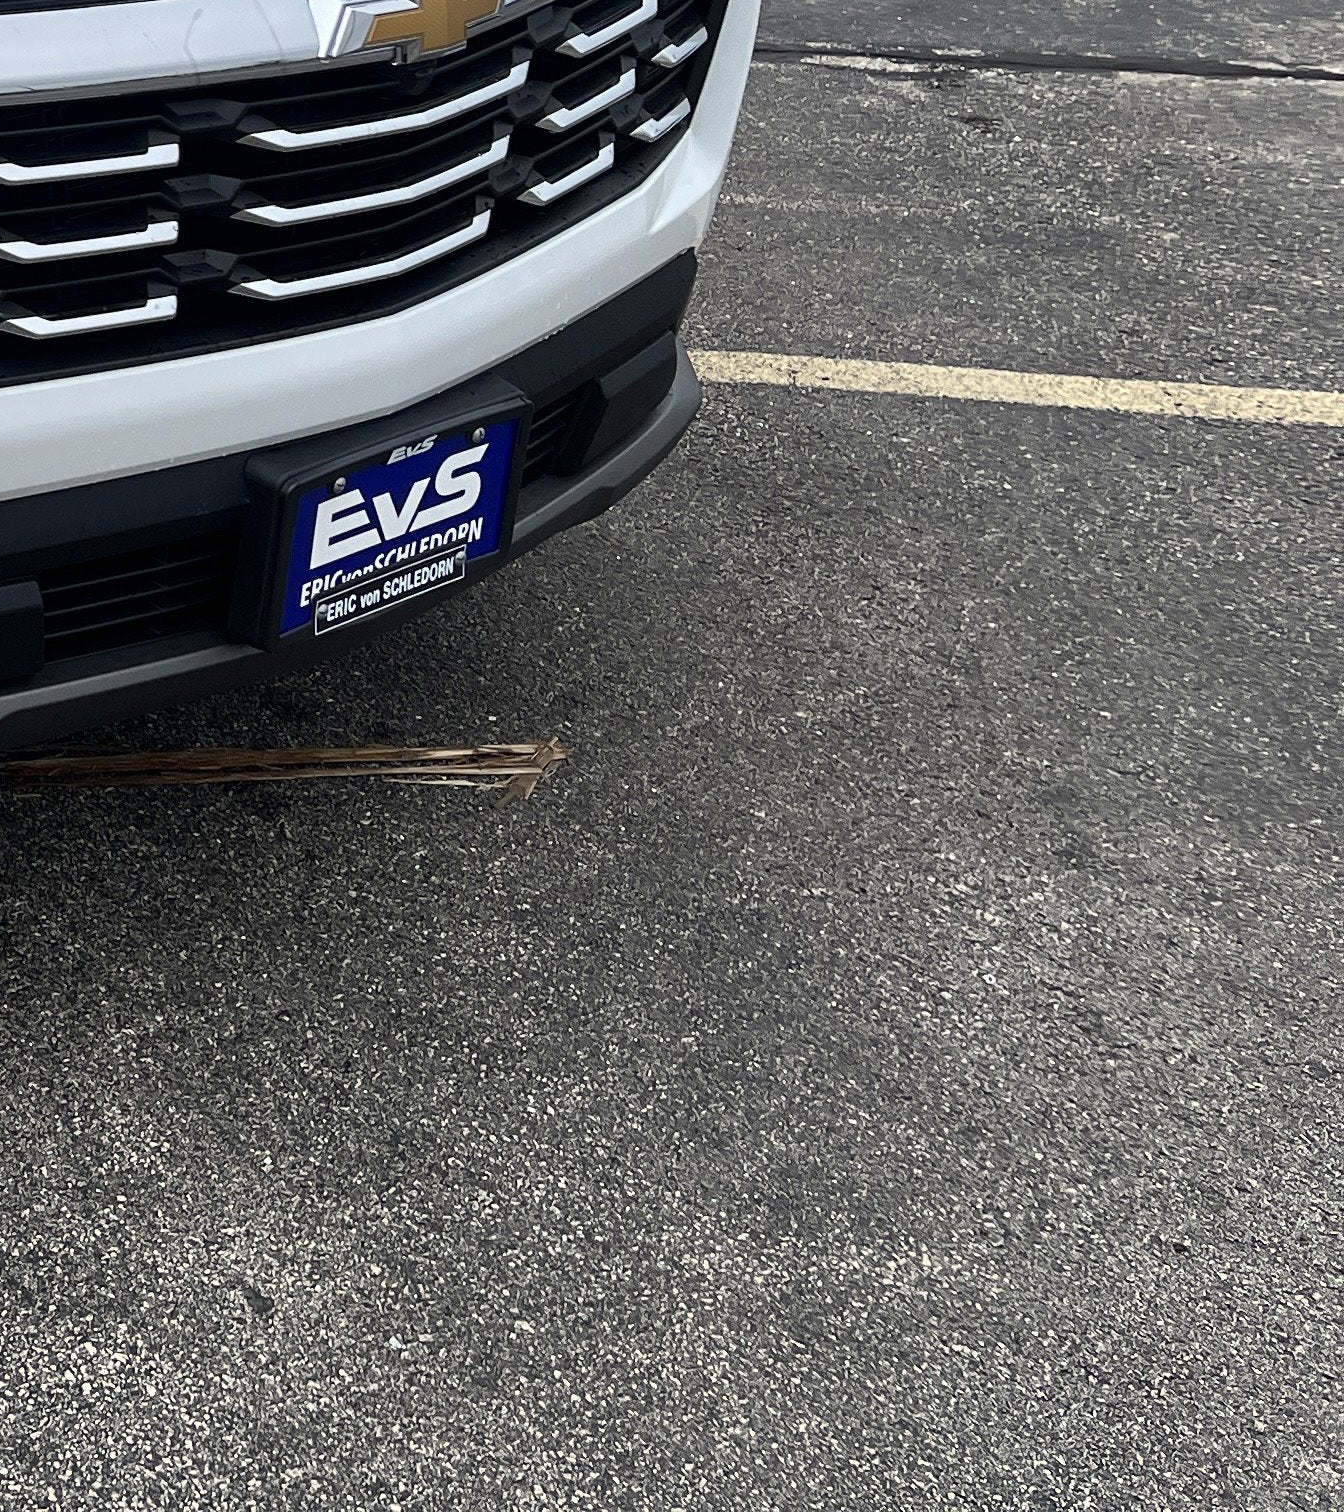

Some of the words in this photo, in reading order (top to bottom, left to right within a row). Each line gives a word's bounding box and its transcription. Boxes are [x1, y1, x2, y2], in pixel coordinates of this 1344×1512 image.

[326, 595, 357, 622] ERIC
[360, 589, 381, 609] von
[383, 556, 455, 600] SCHLEDORN
